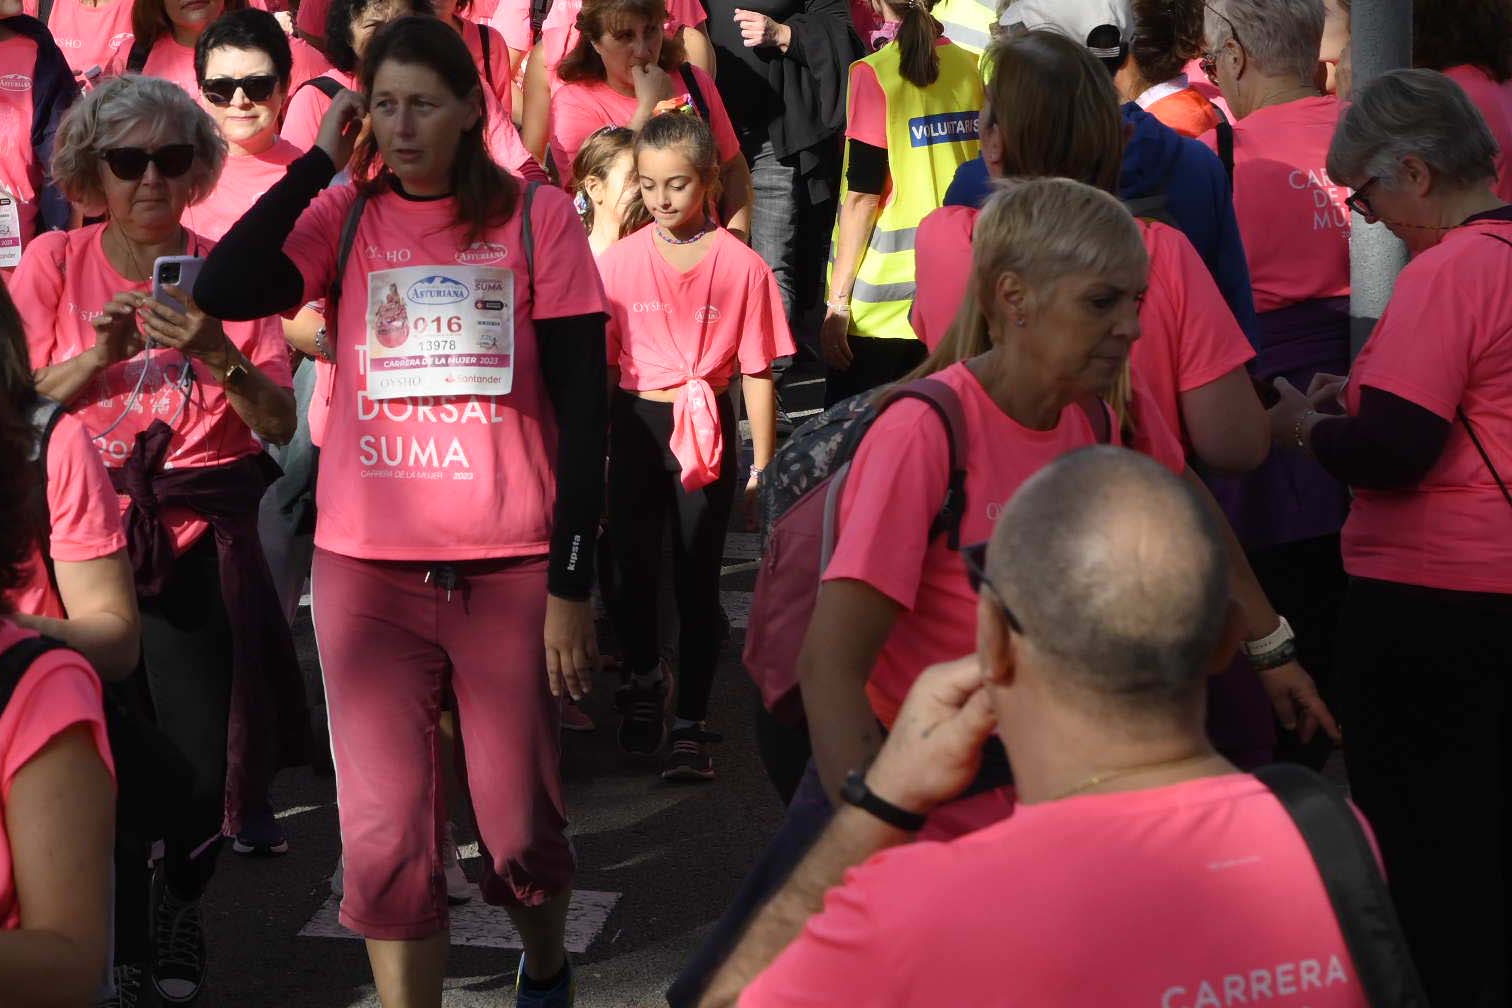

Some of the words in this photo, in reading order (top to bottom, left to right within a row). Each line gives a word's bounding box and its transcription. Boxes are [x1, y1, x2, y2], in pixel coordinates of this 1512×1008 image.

[412, 288, 464, 299] ASTURIANA
[475, 283, 503, 292] SUMA
[413, 315, 463, 334] 016
[418, 339, 457, 351] 13978
[383, 358, 421, 369] CARRERA
[435, 357, 447, 366] LA
[448, 356, 477, 365] MUJER
[479, 355, 499, 364] 2023
[357, 392, 503, 424] DORSAL
[359, 435, 470, 468] SUMA
[568, 535, 580, 571] kipsta
[1161, 954, 1348, 1008] CARRERA
